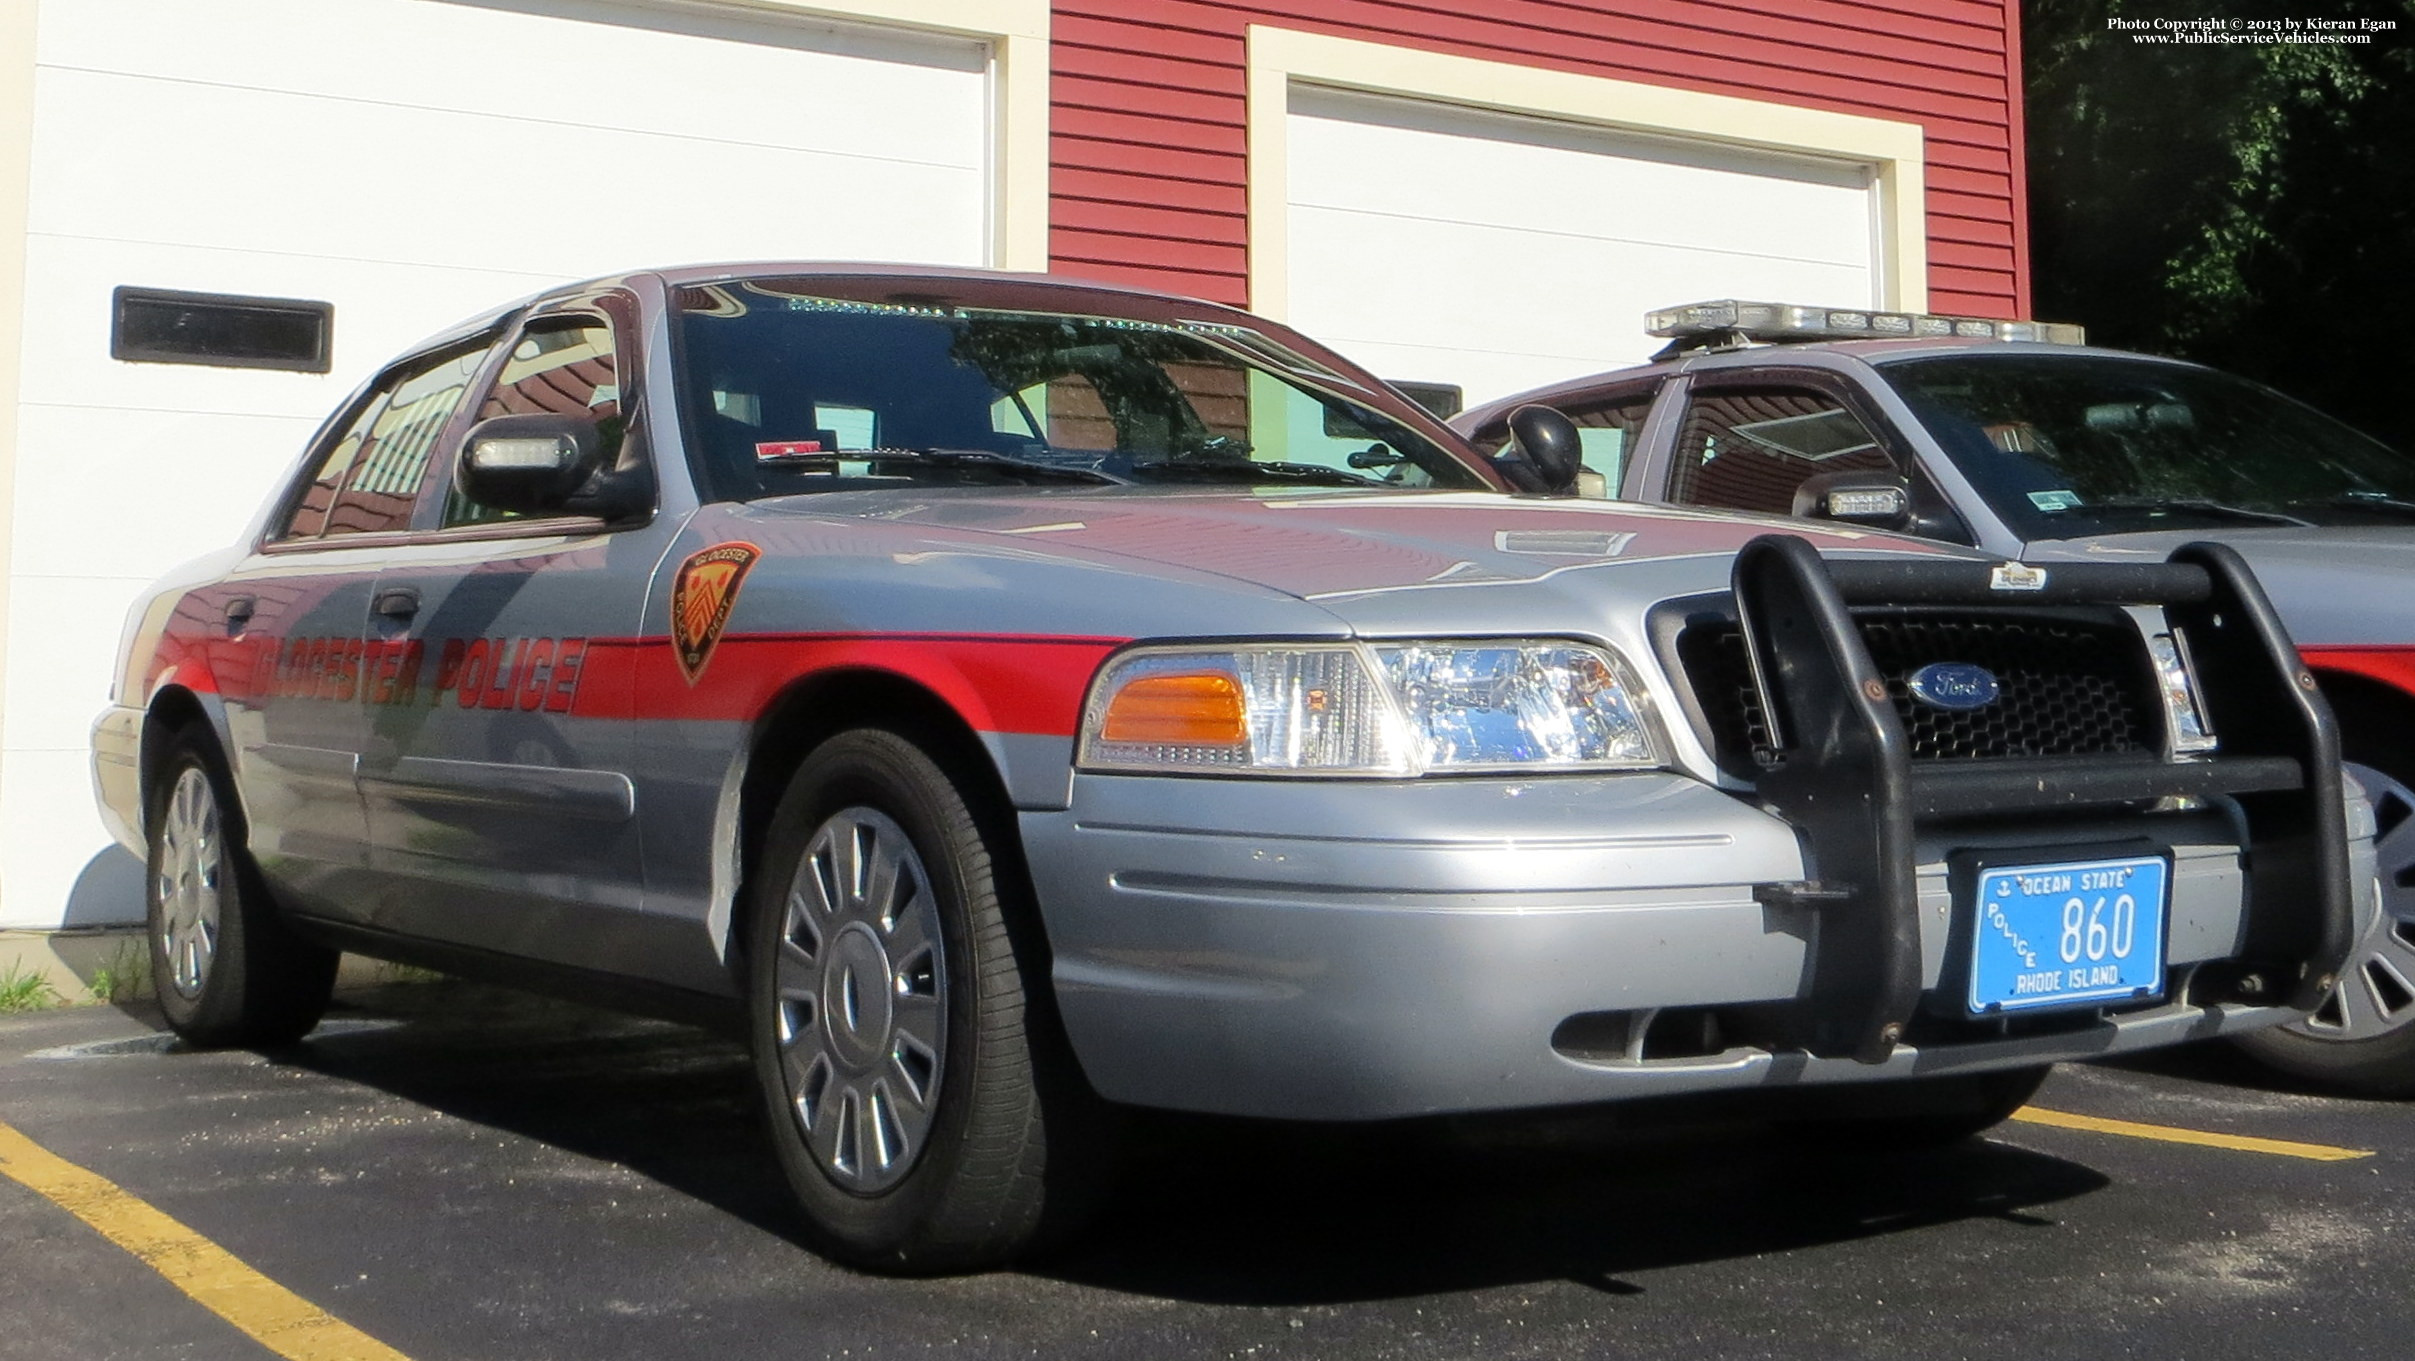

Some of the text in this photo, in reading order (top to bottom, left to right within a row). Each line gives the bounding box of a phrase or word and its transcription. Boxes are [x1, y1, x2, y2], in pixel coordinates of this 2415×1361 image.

[432, 636, 588, 713] POLICE
[1935, 671, 1982, 696] Ford
[2022, 870, 2126, 897] OCEAN STATE
[1987, 902, 2036, 969] POLICE
[2059, 893, 2136, 964] 860
[2016, 964, 2120, 995] RHODE ISLAND
